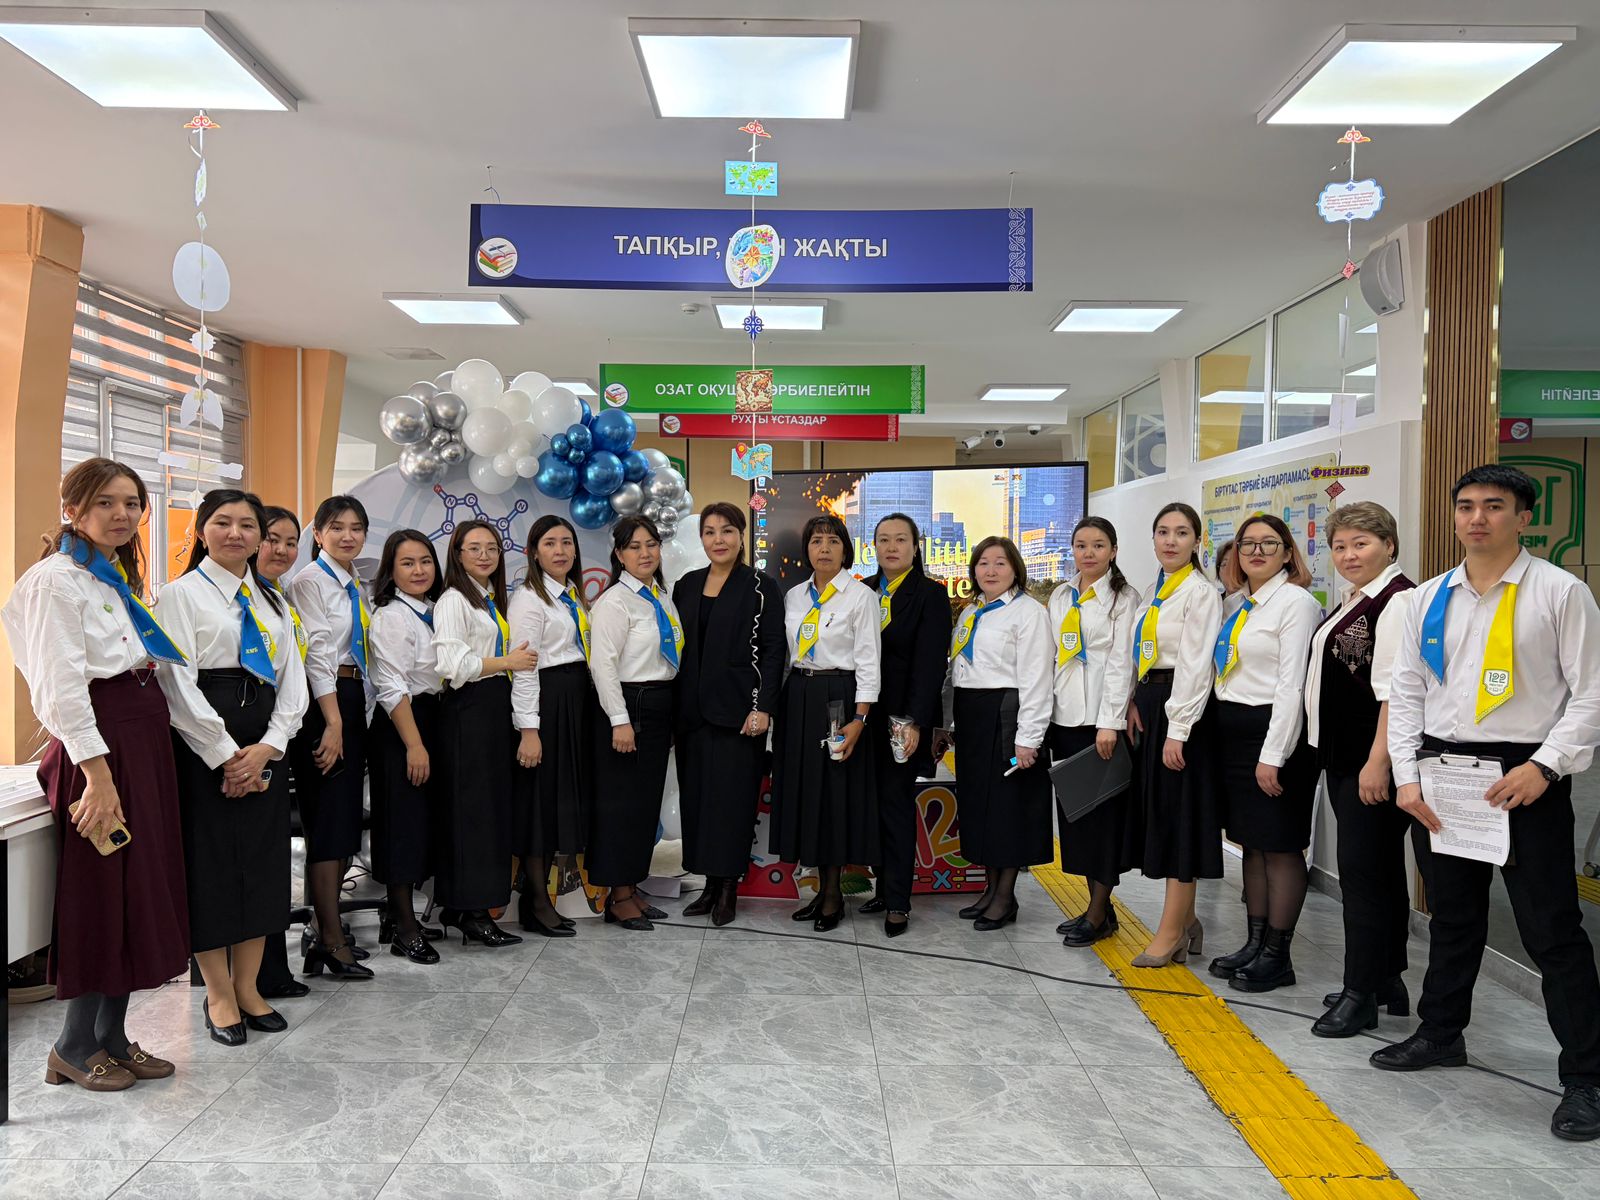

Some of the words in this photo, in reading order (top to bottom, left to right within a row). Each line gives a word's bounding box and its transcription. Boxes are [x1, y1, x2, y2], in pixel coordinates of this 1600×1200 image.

[613, 235, 721, 260] ТАПҚЫР,
[793, 238, 887, 261] ЖАҚТЫ
[655, 383, 693, 396] ОЗАТ
[698, 383, 737, 398] ОҚУШ
[771, 382, 871, 397] ӘРБИЕЛЕЙТІН
[731, 414, 768, 424] РУХТЫ
[771, 414, 827, 426] ҰСТАЗДАР
[1311, 465, 1370, 479] Физика
[925, 536, 975, 566] littl
[1488, 671, 1507, 684] 122
